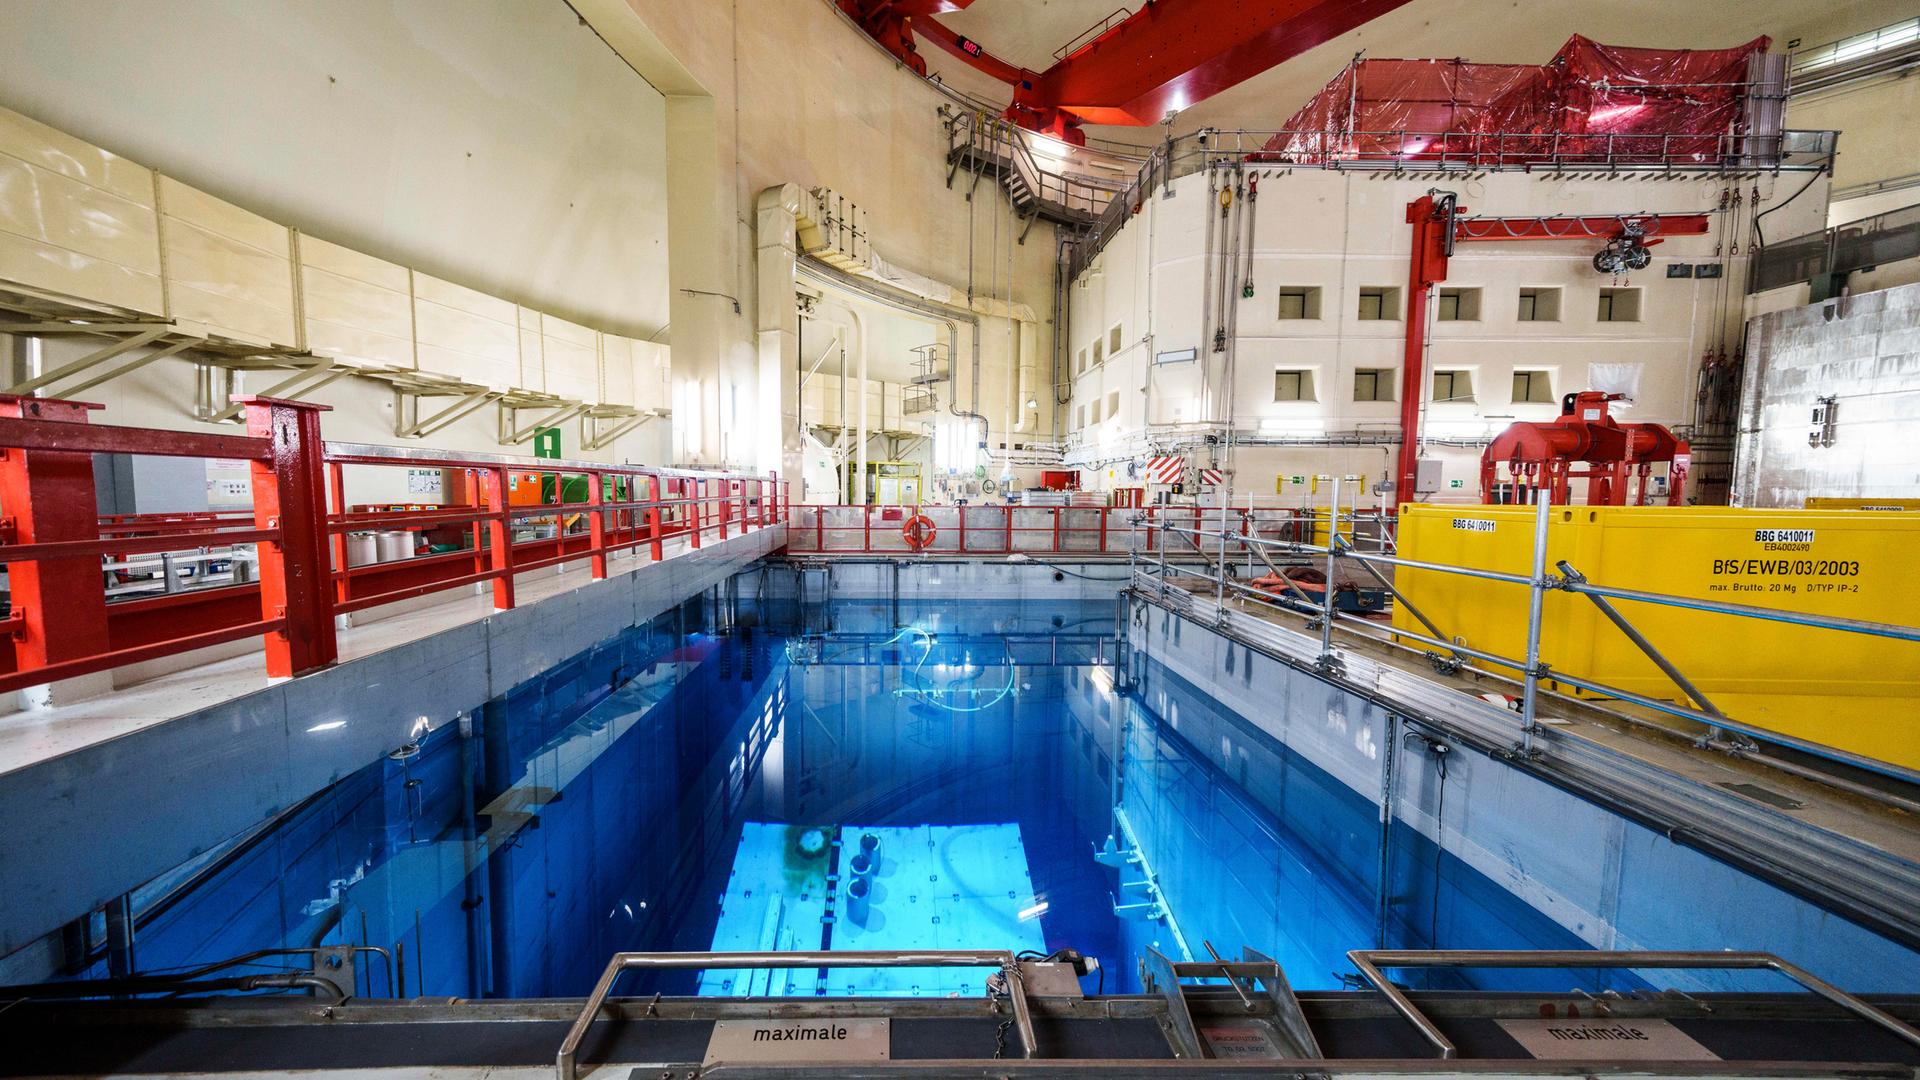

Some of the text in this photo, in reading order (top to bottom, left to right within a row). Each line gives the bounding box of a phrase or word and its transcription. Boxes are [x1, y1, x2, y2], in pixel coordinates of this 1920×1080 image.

[1453, 519, 1466, 528] BBG
[1755, 530, 1813, 542] BBG 6410011
[1764, 543, 1810, 551] EB4002490
[1713, 559, 1860, 576] BfS/EWB/03/2003
[1709, 584, 1730, 592] max.
[1769, 583, 1781, 592] 20
[1783, 583, 1797, 594] Mg
[1806, 583, 1859, 593] D/TYP IP-2
[754, 1024, 847, 1041] maximale
[1547, 1024, 1648, 1041] maximale
